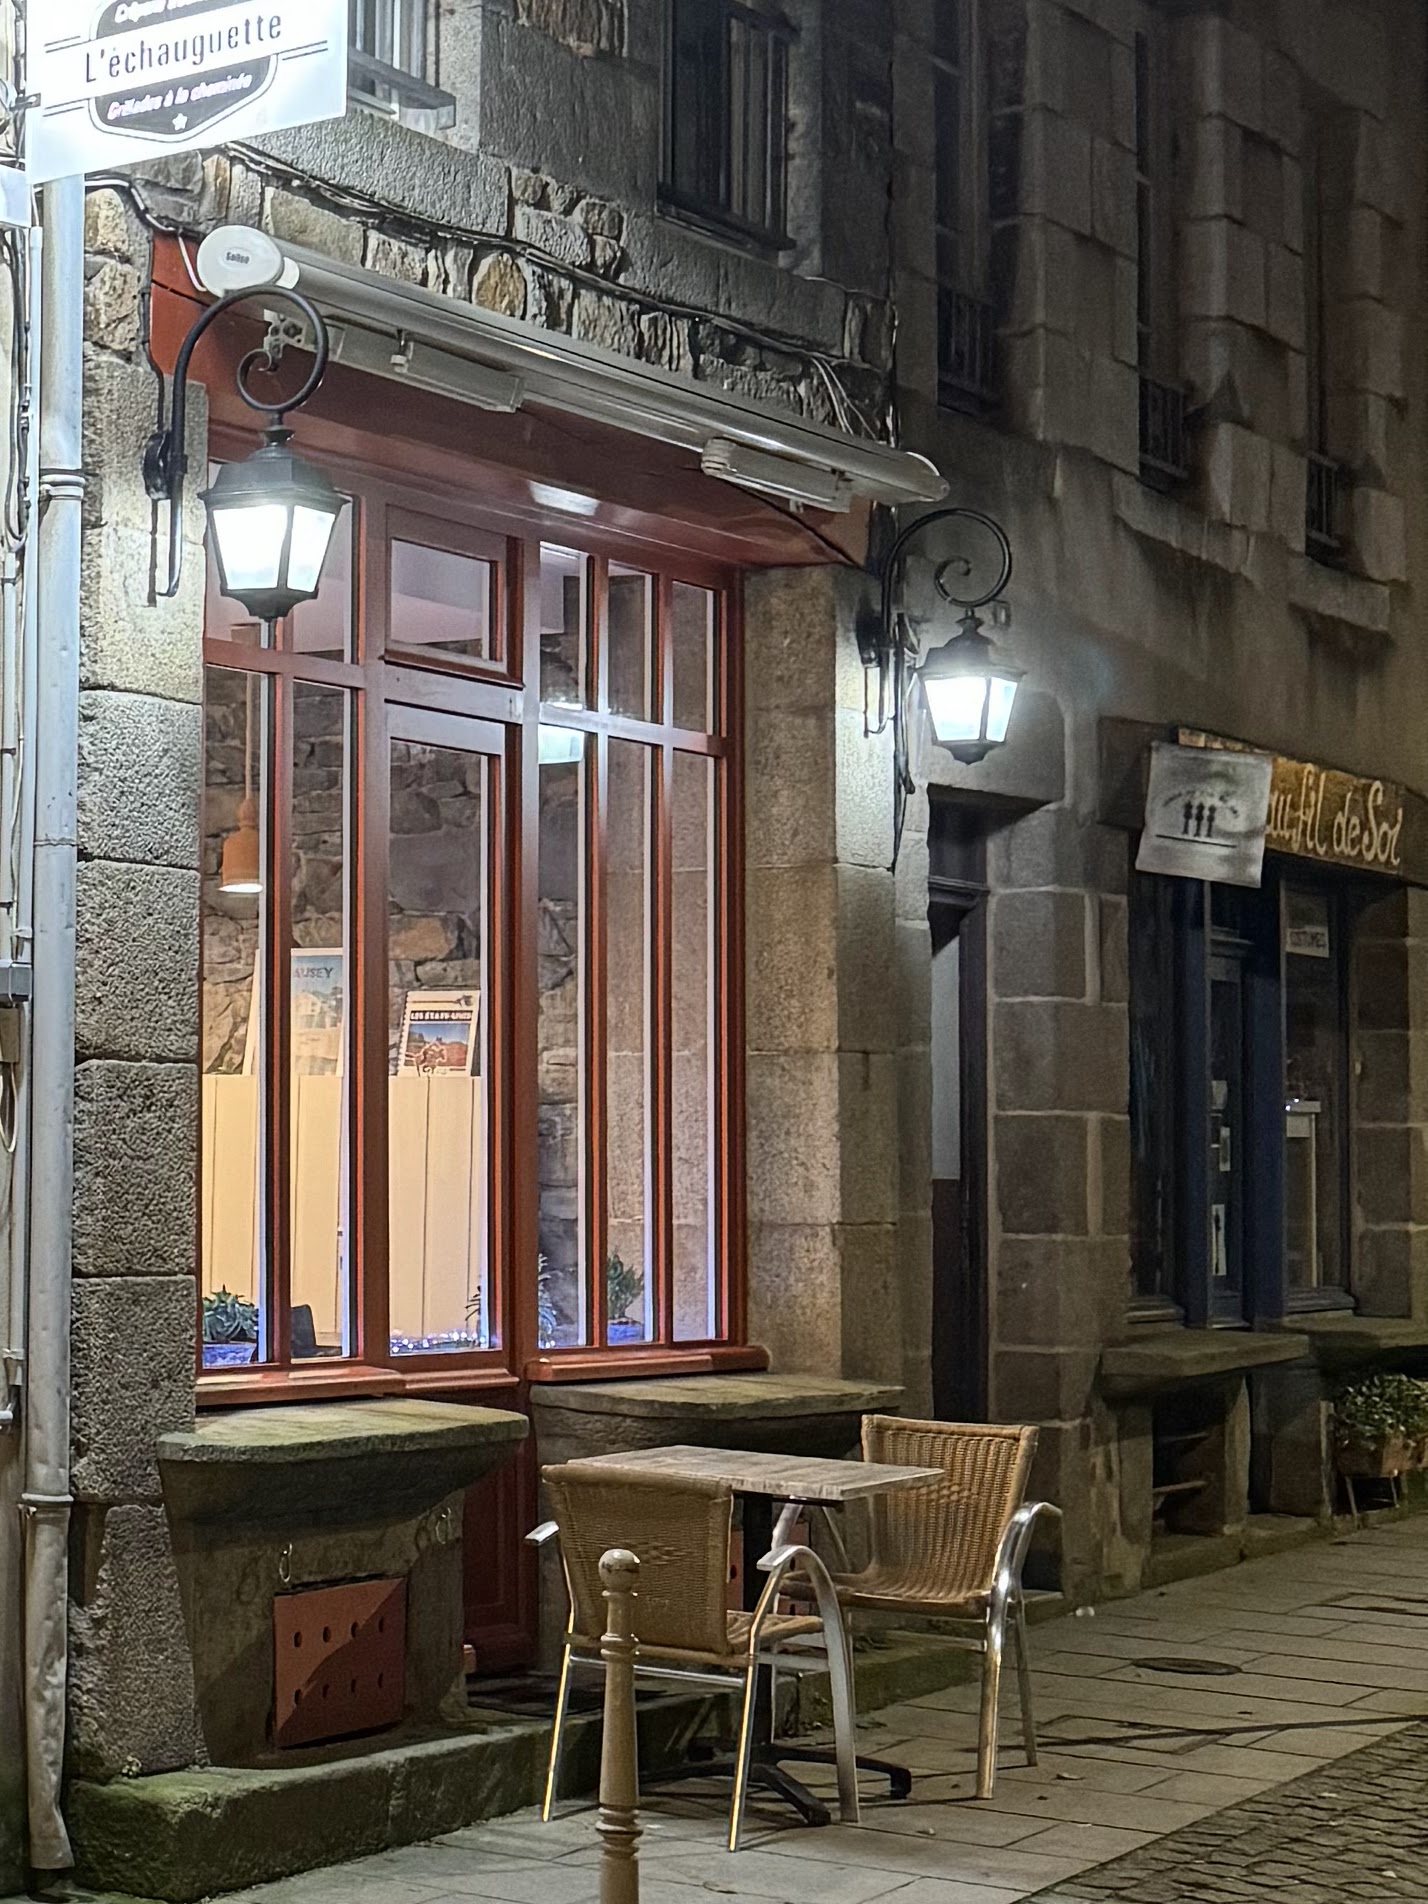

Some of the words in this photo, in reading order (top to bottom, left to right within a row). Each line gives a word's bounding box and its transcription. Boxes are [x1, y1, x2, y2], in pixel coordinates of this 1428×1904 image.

[84, 14, 282, 83] L'échauguette
[1265, 790, 1293, 841] u
[1333, 786, 1361, 857] de
